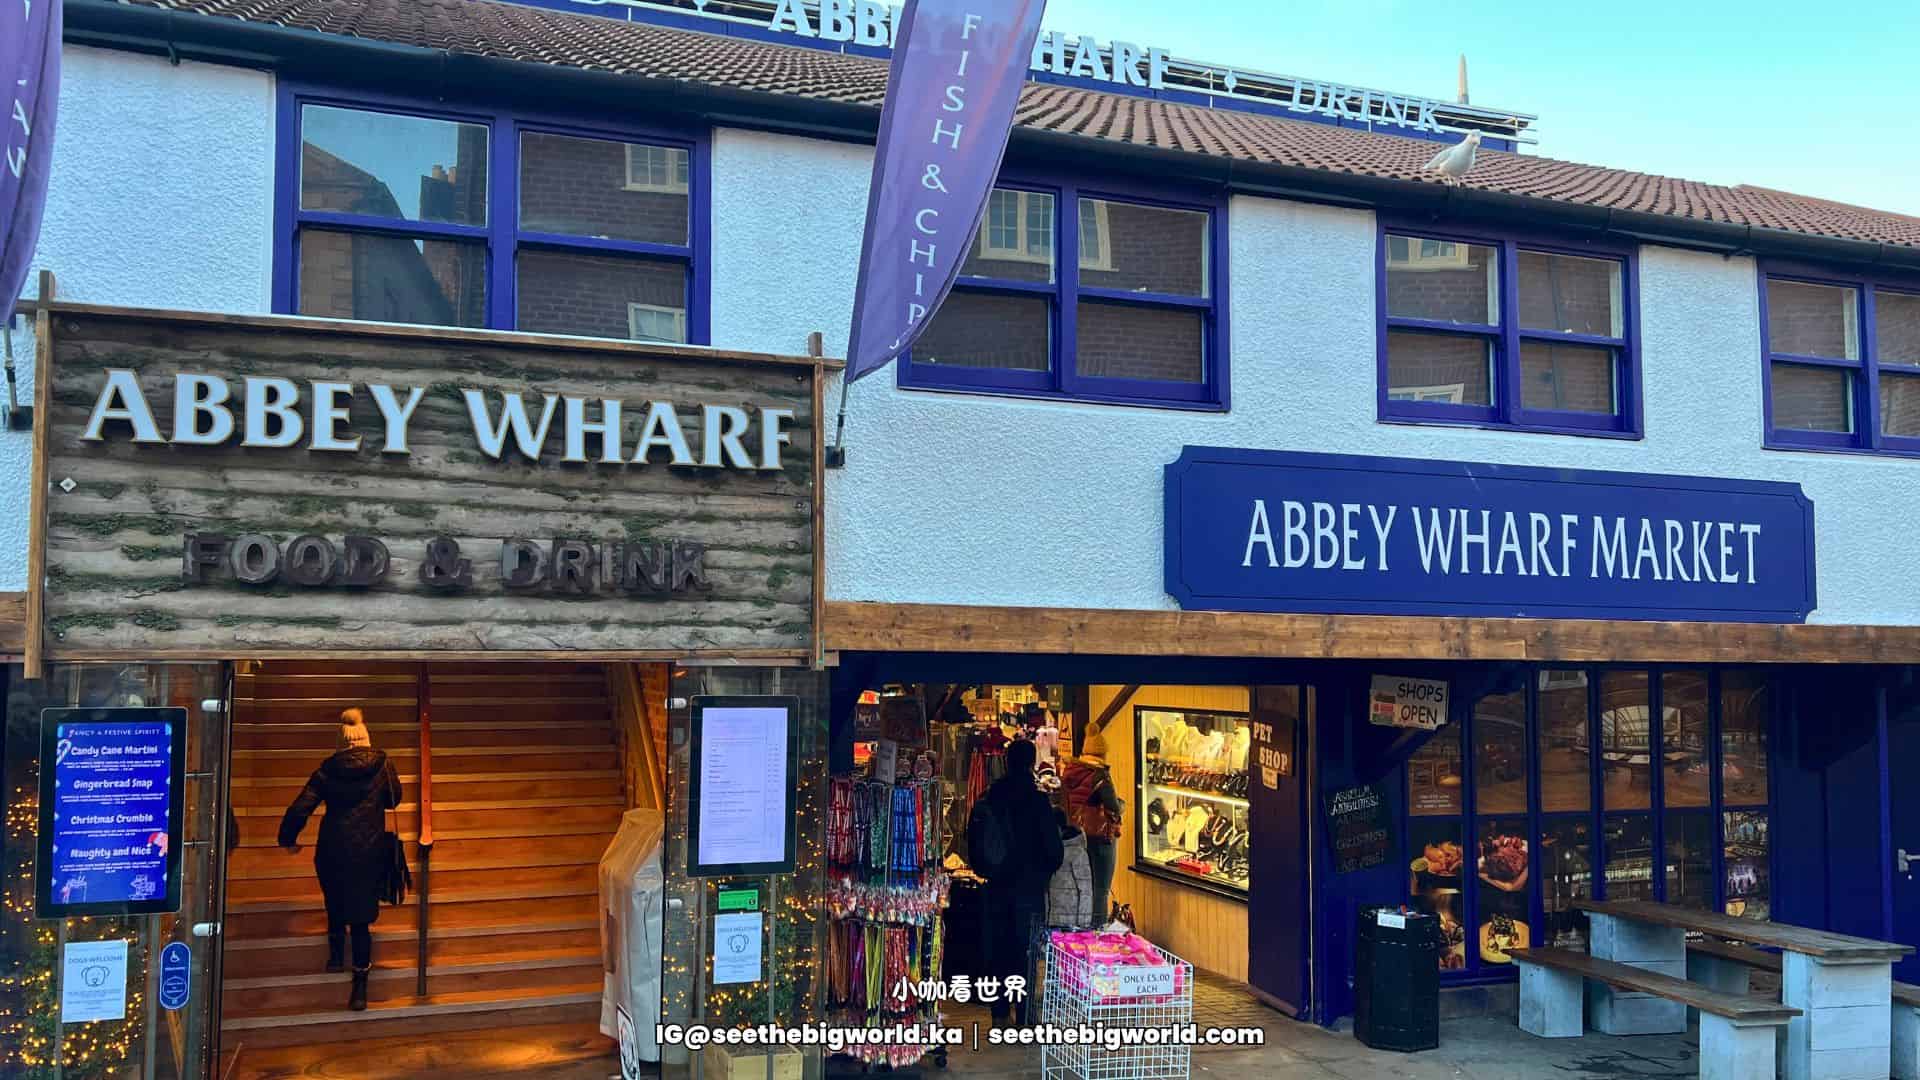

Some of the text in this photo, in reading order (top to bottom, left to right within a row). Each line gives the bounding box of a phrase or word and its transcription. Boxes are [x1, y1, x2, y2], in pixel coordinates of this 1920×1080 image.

[767, 0, 1444, 134] ABB HARF DRINK
[931, 13, 982, 150] FISH
[920, 163, 949, 194] &
[80, 367, 794, 471] ABBEY WHARF
[1241, 498, 1761, 584] ABBEY WHARF MARKET
[182, 533, 712, 593] FOOD & DRINK
[1397, 682, 1443, 702] SHOPS
[1401, 704, 1438, 725] OPEN
[1253, 721, 1273, 743] PET
[71, 744, 158, 757] Candy Cane Martini
[1259, 746, 1289, 771] SHOP
[73, 778, 153, 791] Gingerbread Snap
[71, 813, 154, 825] Christmas Crumble
[70, 846, 152, 859] Naughty and Nice
[1124, 974, 1170, 984] ONLY £5.00
[1137, 985, 1158, 993] EACH
